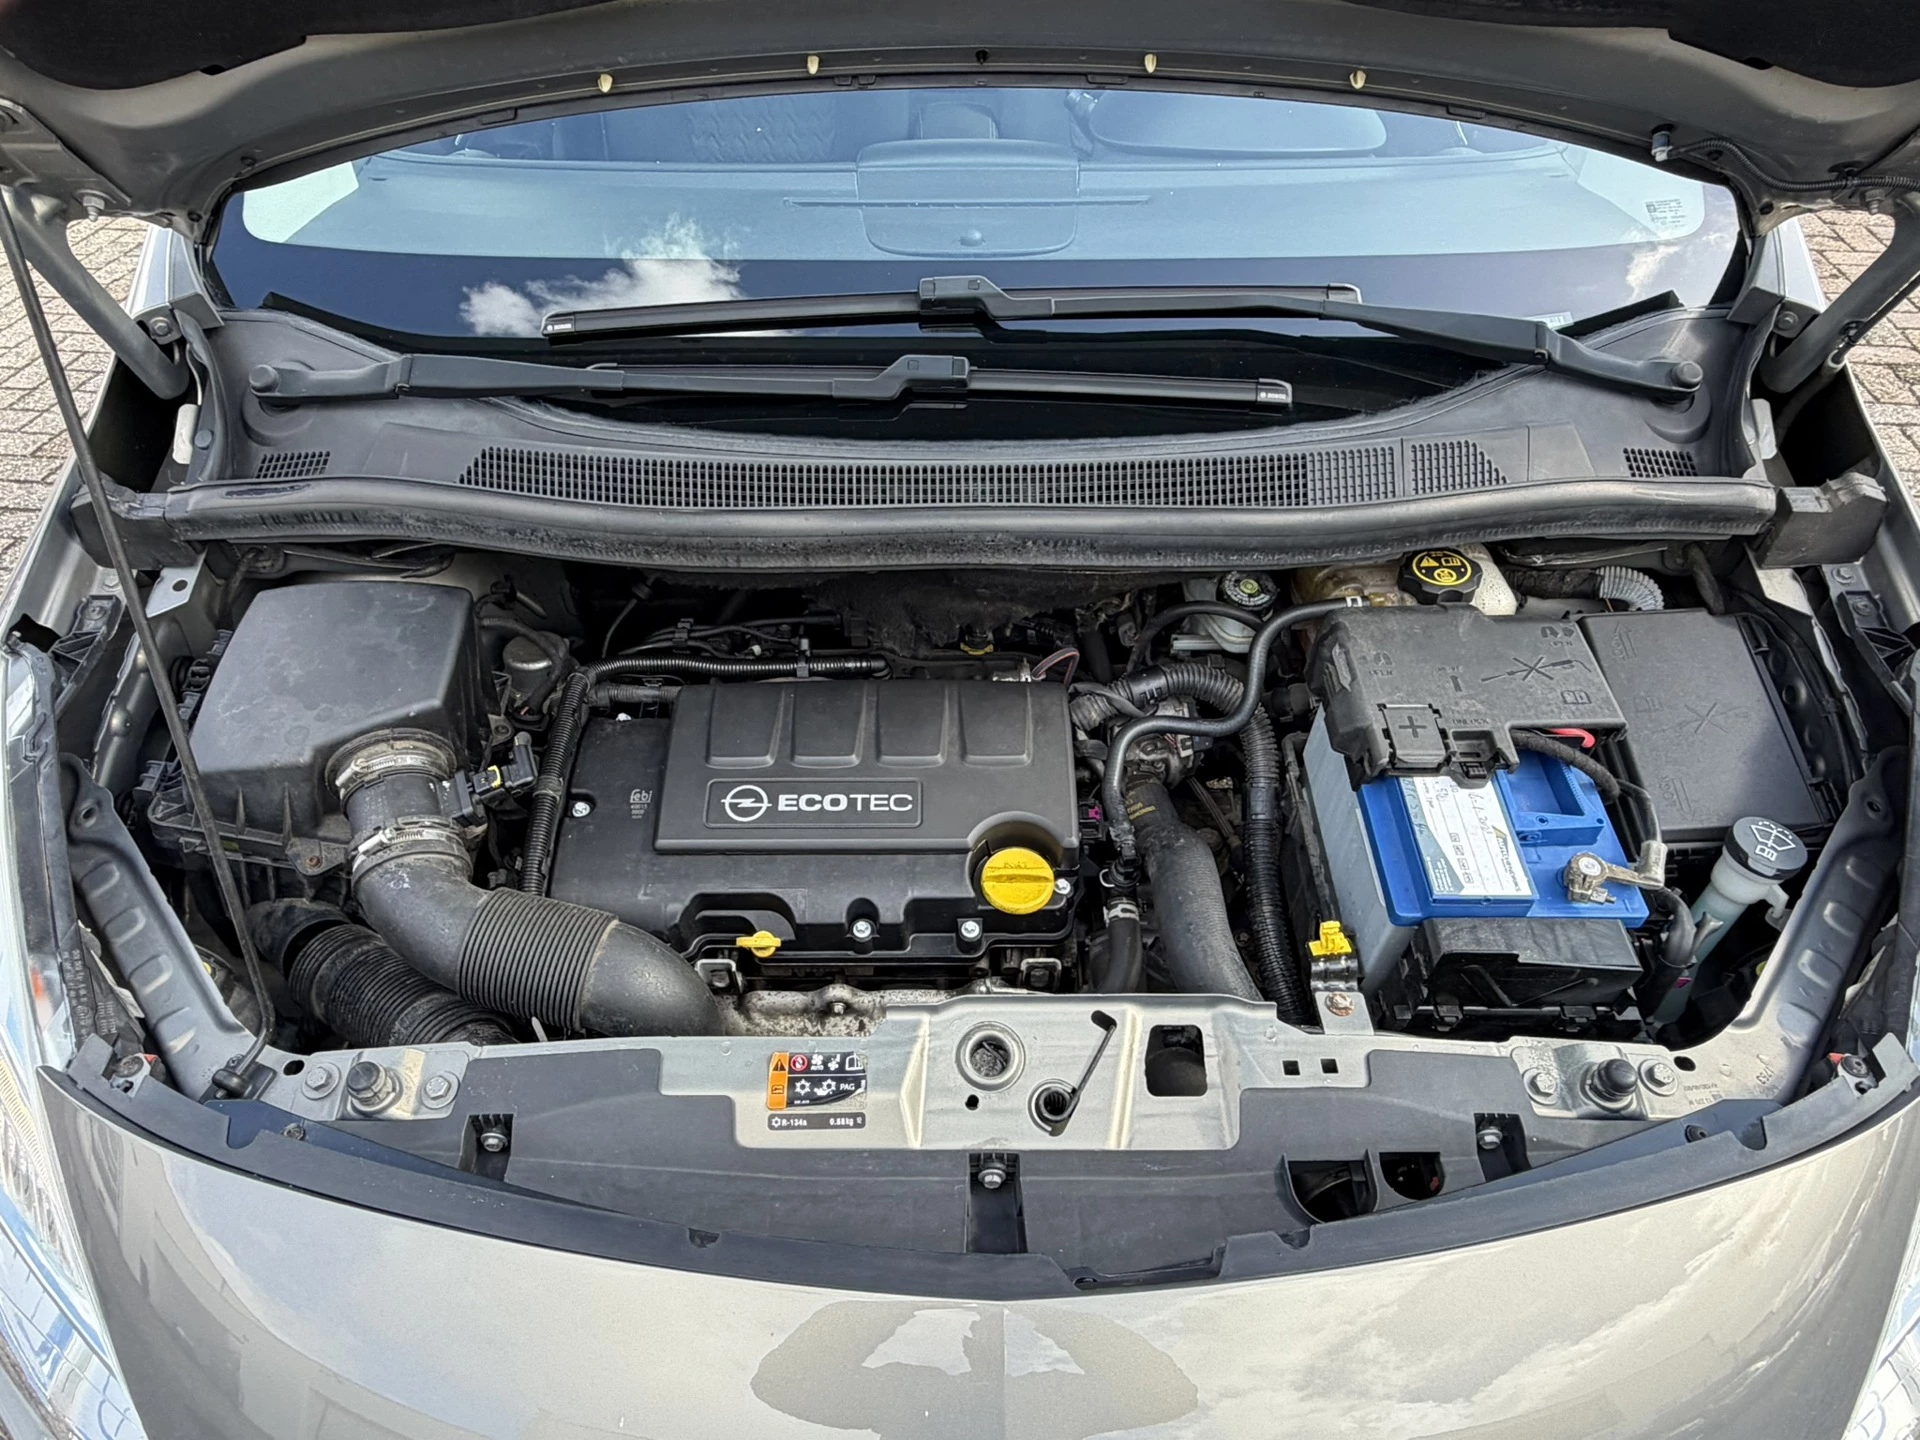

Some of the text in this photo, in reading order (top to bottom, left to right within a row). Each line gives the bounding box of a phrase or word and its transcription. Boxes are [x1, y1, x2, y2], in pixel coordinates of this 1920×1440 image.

[777, 793, 913, 812] ECOTEC
[839, 1083, 855, 1091] PAG
[781, 1118, 807, 1127] R-134a
